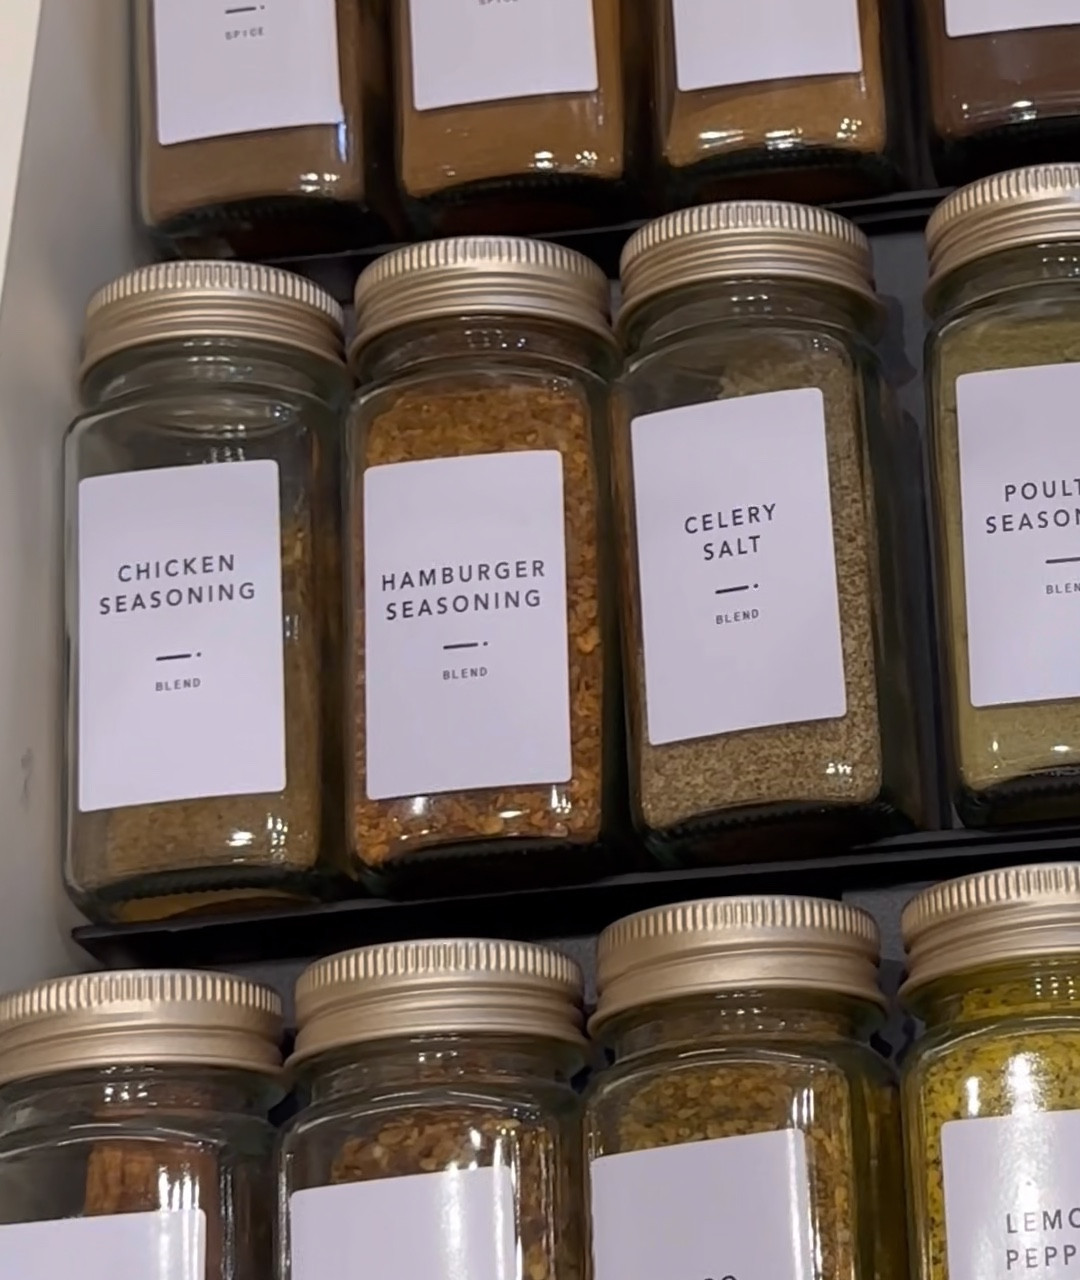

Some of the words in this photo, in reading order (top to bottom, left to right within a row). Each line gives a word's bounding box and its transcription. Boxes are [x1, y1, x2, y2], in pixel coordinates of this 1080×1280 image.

[224, 26, 265, 41] SPICE
[684, 503, 776, 535] CELERY
[703, 534, 761, 561] SALT
[117, 553, 235, 583] CHICKEN
[381, 559, 545, 592] HAMBURGER
[99, 581, 255, 616] SEASONING
[385, 588, 541, 621] SEASONING
[715, 608, 760, 625] BLEND
[154, 677, 202, 692] BLEND
[442, 666, 488, 681] BLEND
